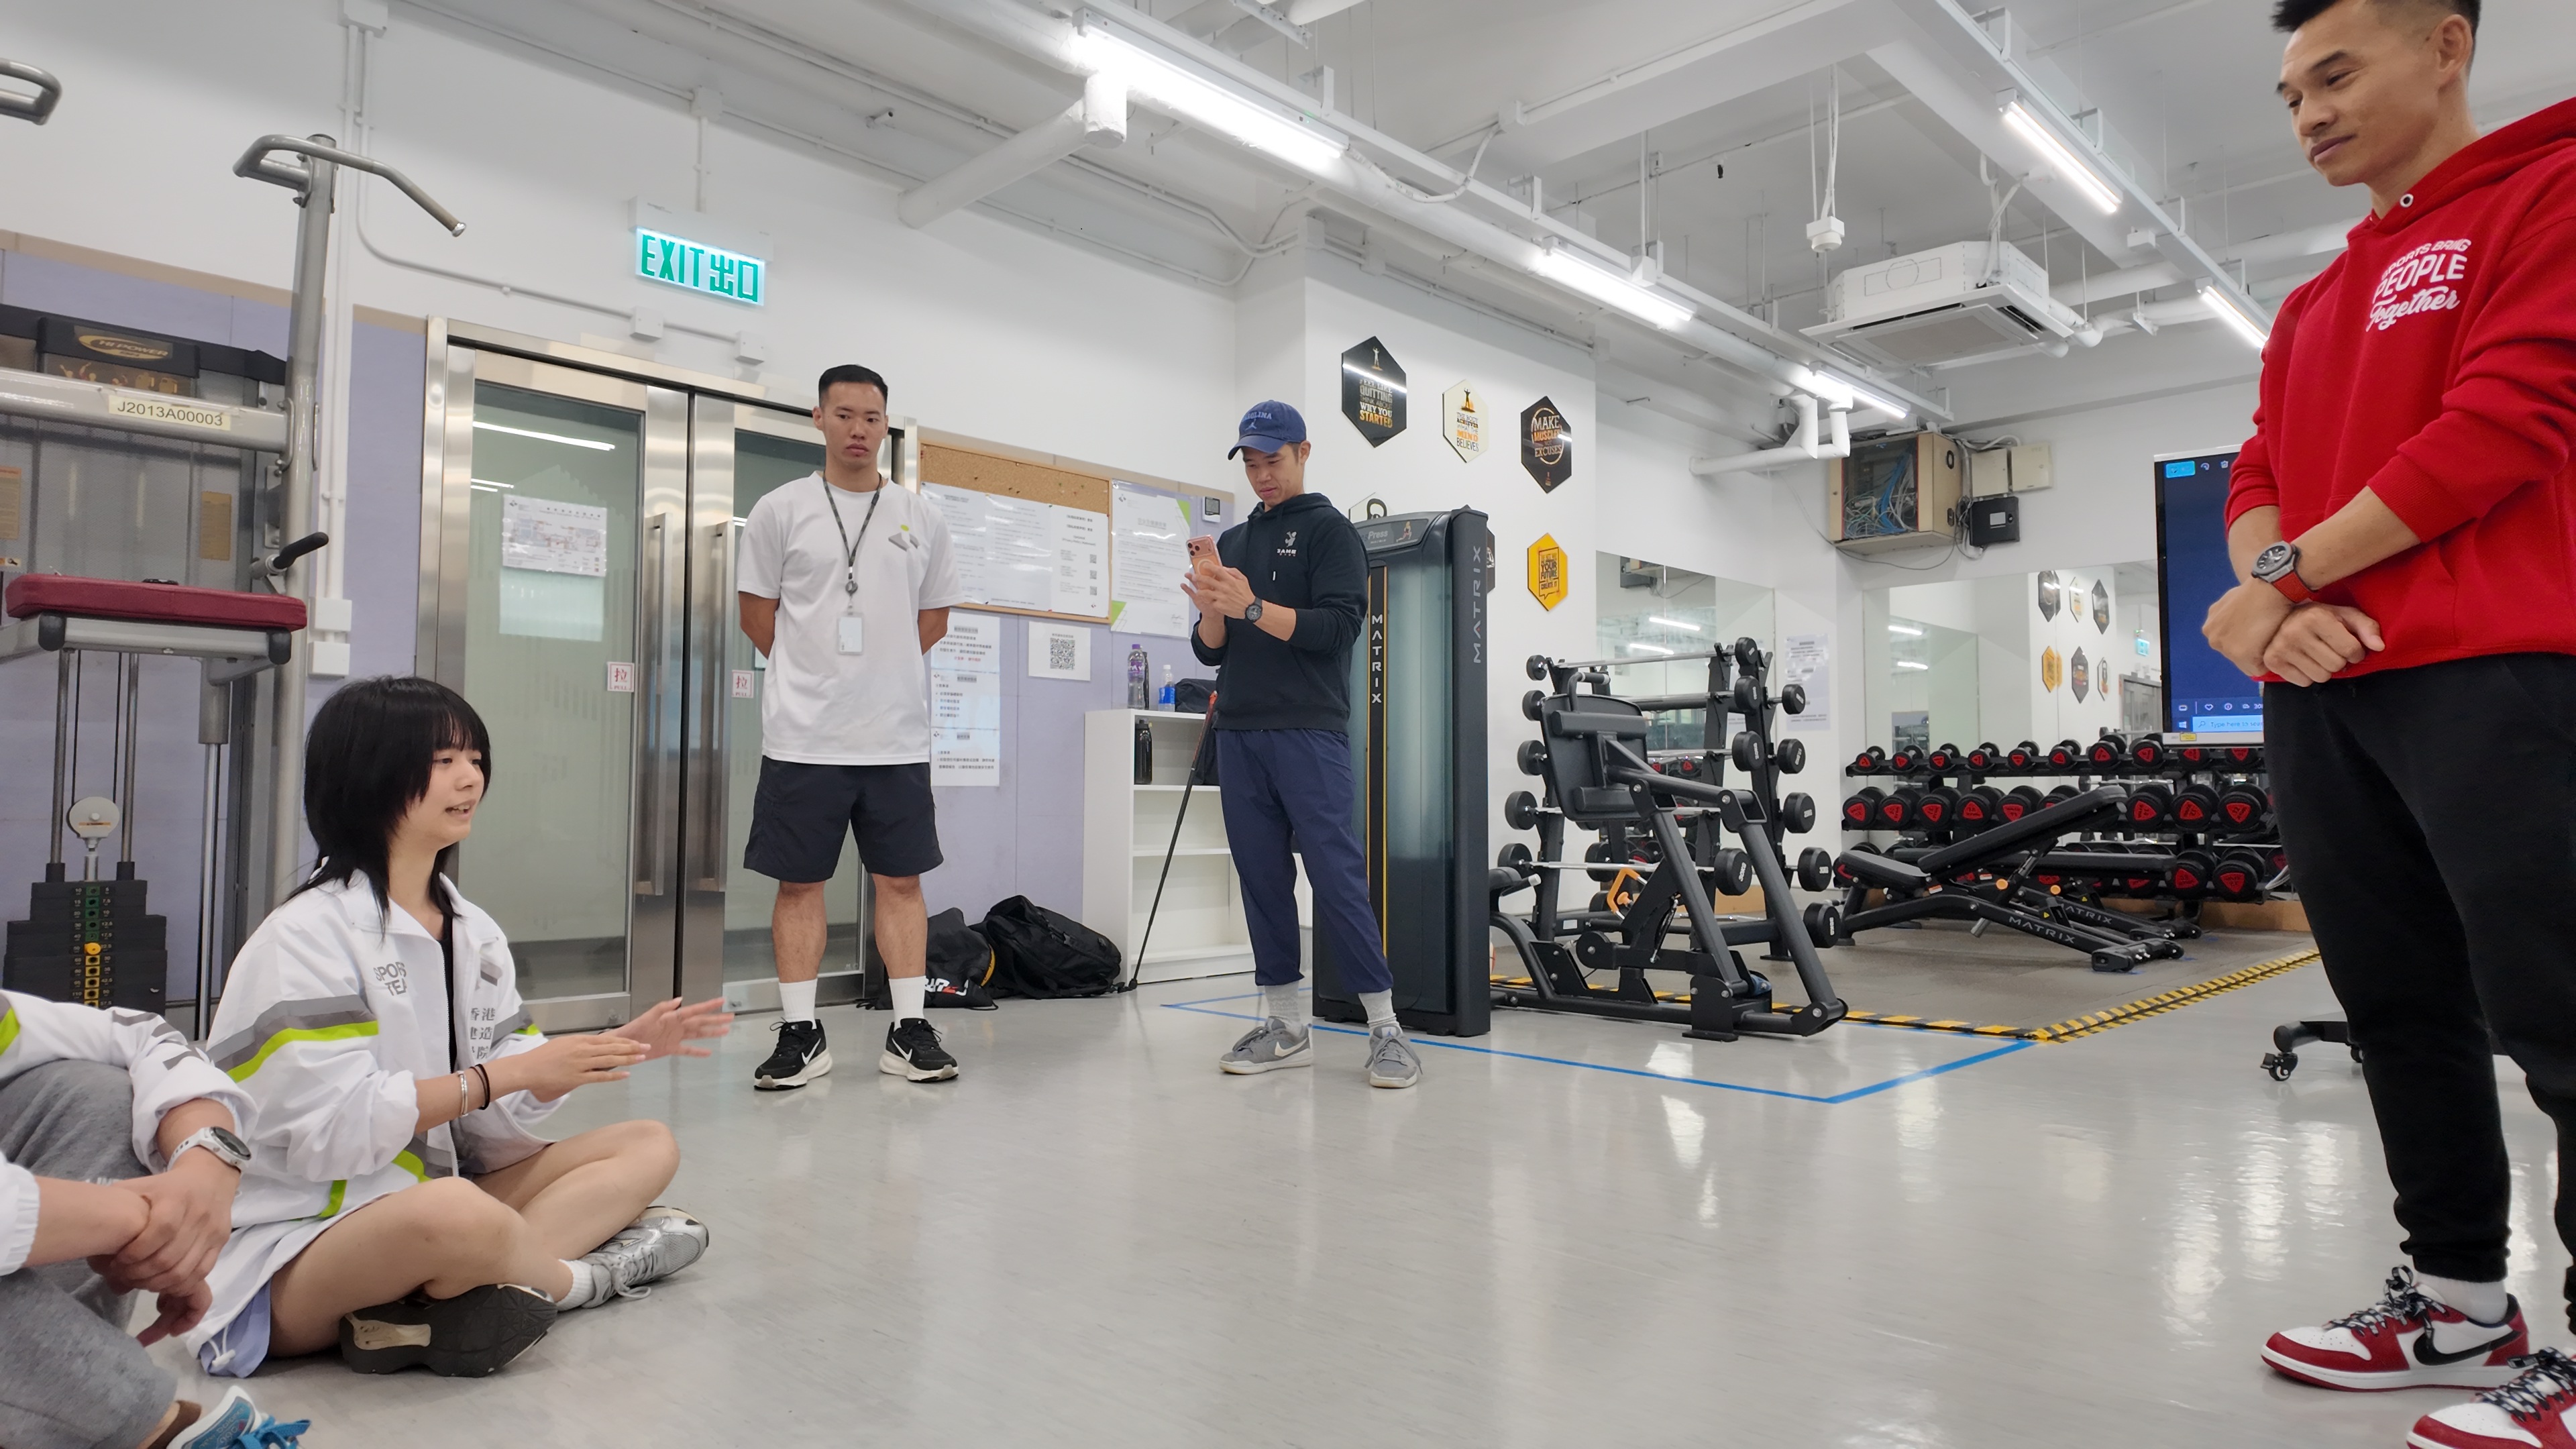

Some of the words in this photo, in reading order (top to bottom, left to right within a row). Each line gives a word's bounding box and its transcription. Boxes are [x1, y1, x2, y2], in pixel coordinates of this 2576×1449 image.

[641, 234, 704, 287] EXIT
[710, 254, 758, 303] 出口
[2372, 254, 2467, 304] PEOPLE
[2366, 286, 2460, 332] Together
[115, 343, 168, 357] POWER
[1360, 384, 1393, 403] QUITTING
[117, 401, 223, 426] J2013A00003
[1360, 402, 1377, 413] WHY
[1379, 407, 1393, 418] YOU
[1360, 409, 1393, 428] STARTED
[1534, 415, 1560, 431] MAKE
[1456, 430, 1479, 442] MIND
[1456, 437, 1479, 451] BELIEVES
[1535, 445, 1562, 457] EXCUSES
[1368, 531, 1388, 539] Press
[1473, 546, 1481, 663] MATRIX
[1372, 614, 1383, 703] MATRIX
[614, 667, 627, 682] 拉
[2060, 903, 2112, 924] ATRIX
[2008, 916, 2075, 944] MATRIX
[471, 1008, 495, 1021] 香港
